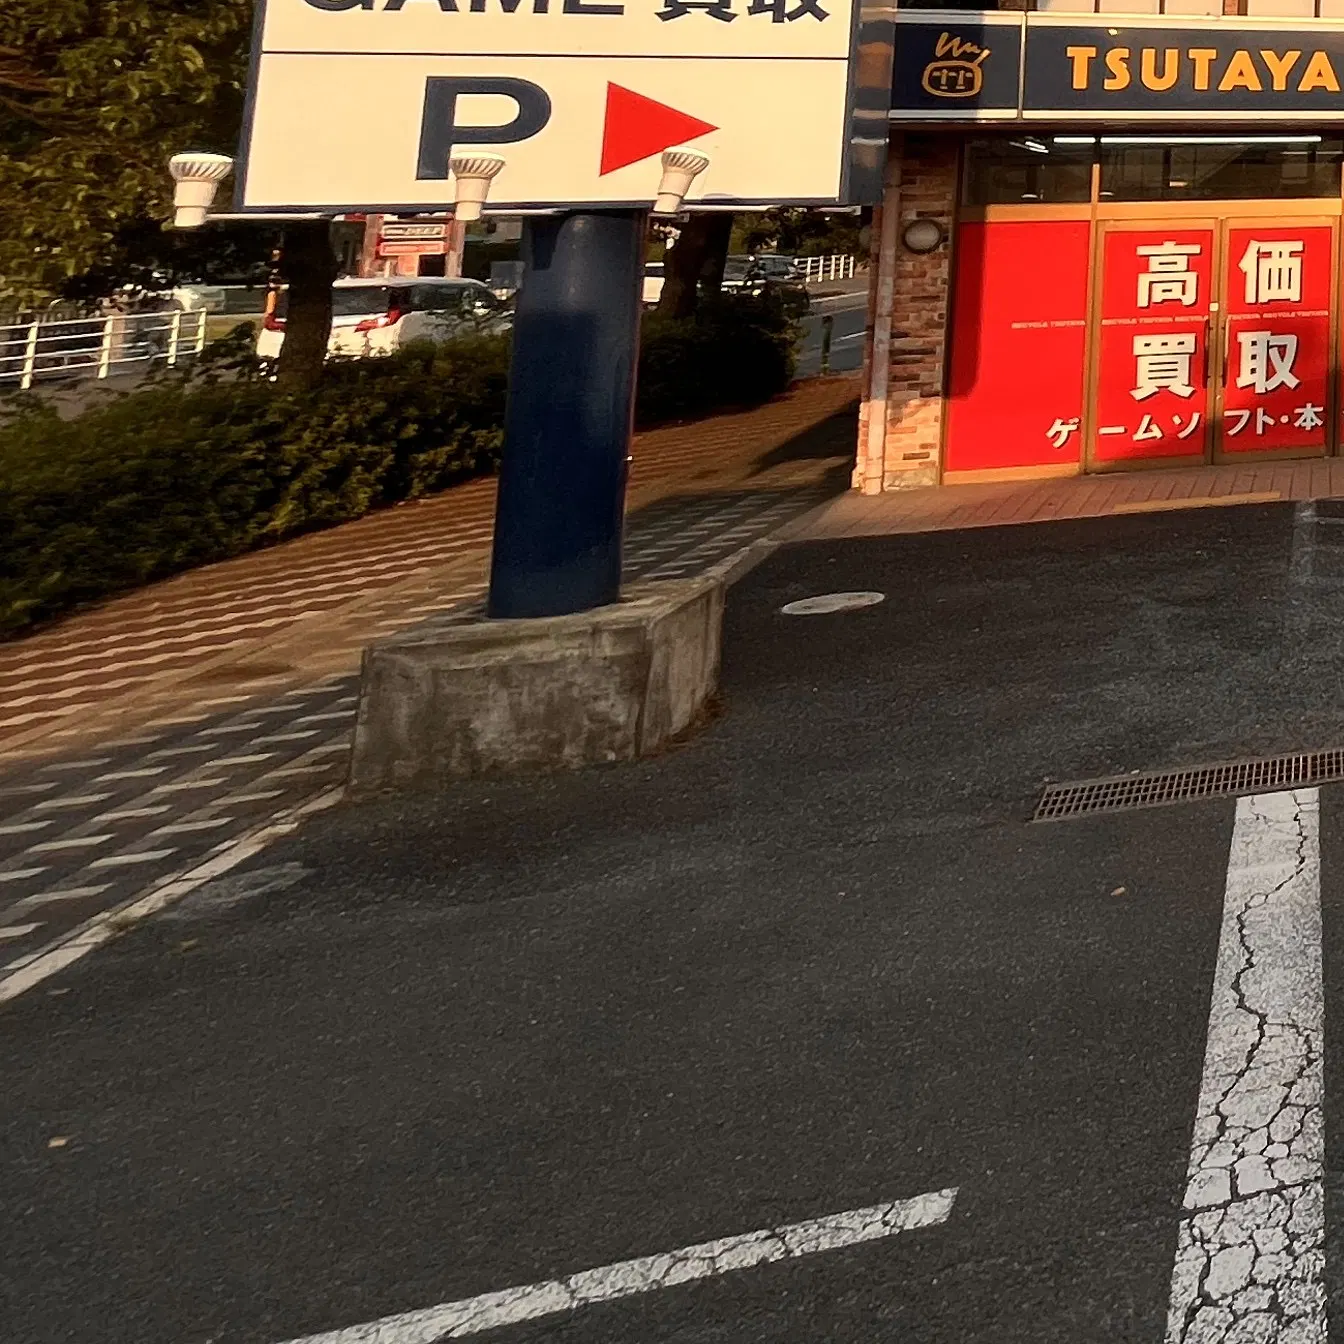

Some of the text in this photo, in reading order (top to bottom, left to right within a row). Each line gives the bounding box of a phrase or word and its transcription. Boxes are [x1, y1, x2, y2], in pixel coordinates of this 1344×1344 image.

[1066, 44, 1341, 94] TSUTAYA
[415, 73, 554, 182] P
[1136, 240, 1304, 308] 高価
[1129, 330, 1301, 401] 買取
